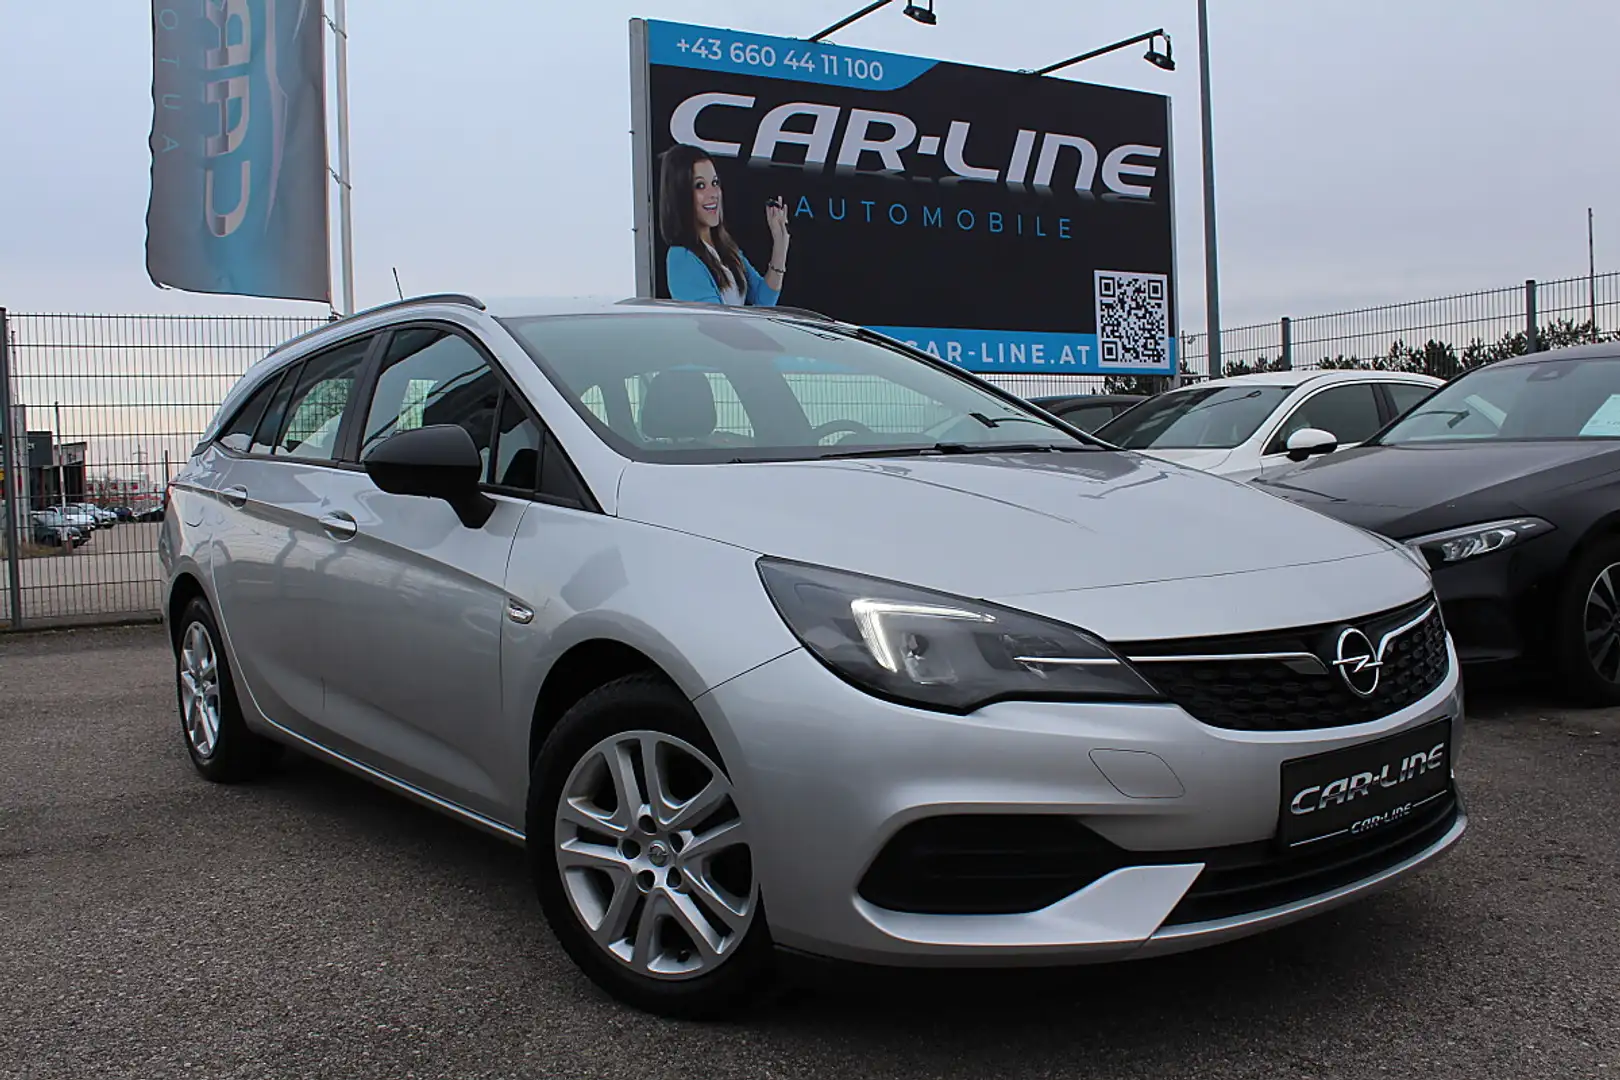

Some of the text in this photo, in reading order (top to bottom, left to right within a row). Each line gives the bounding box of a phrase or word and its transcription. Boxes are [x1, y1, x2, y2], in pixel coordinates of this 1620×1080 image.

[676, 37, 884, 81] +43 660 44 11 100
[669, 91, 1162, 197] CAR-LINE
[794, 196, 1073, 239] AUTOMOBILE
[1290, 742, 1445, 816] CAR-LINE
[1351, 802, 1413, 834] CAR-LINE
